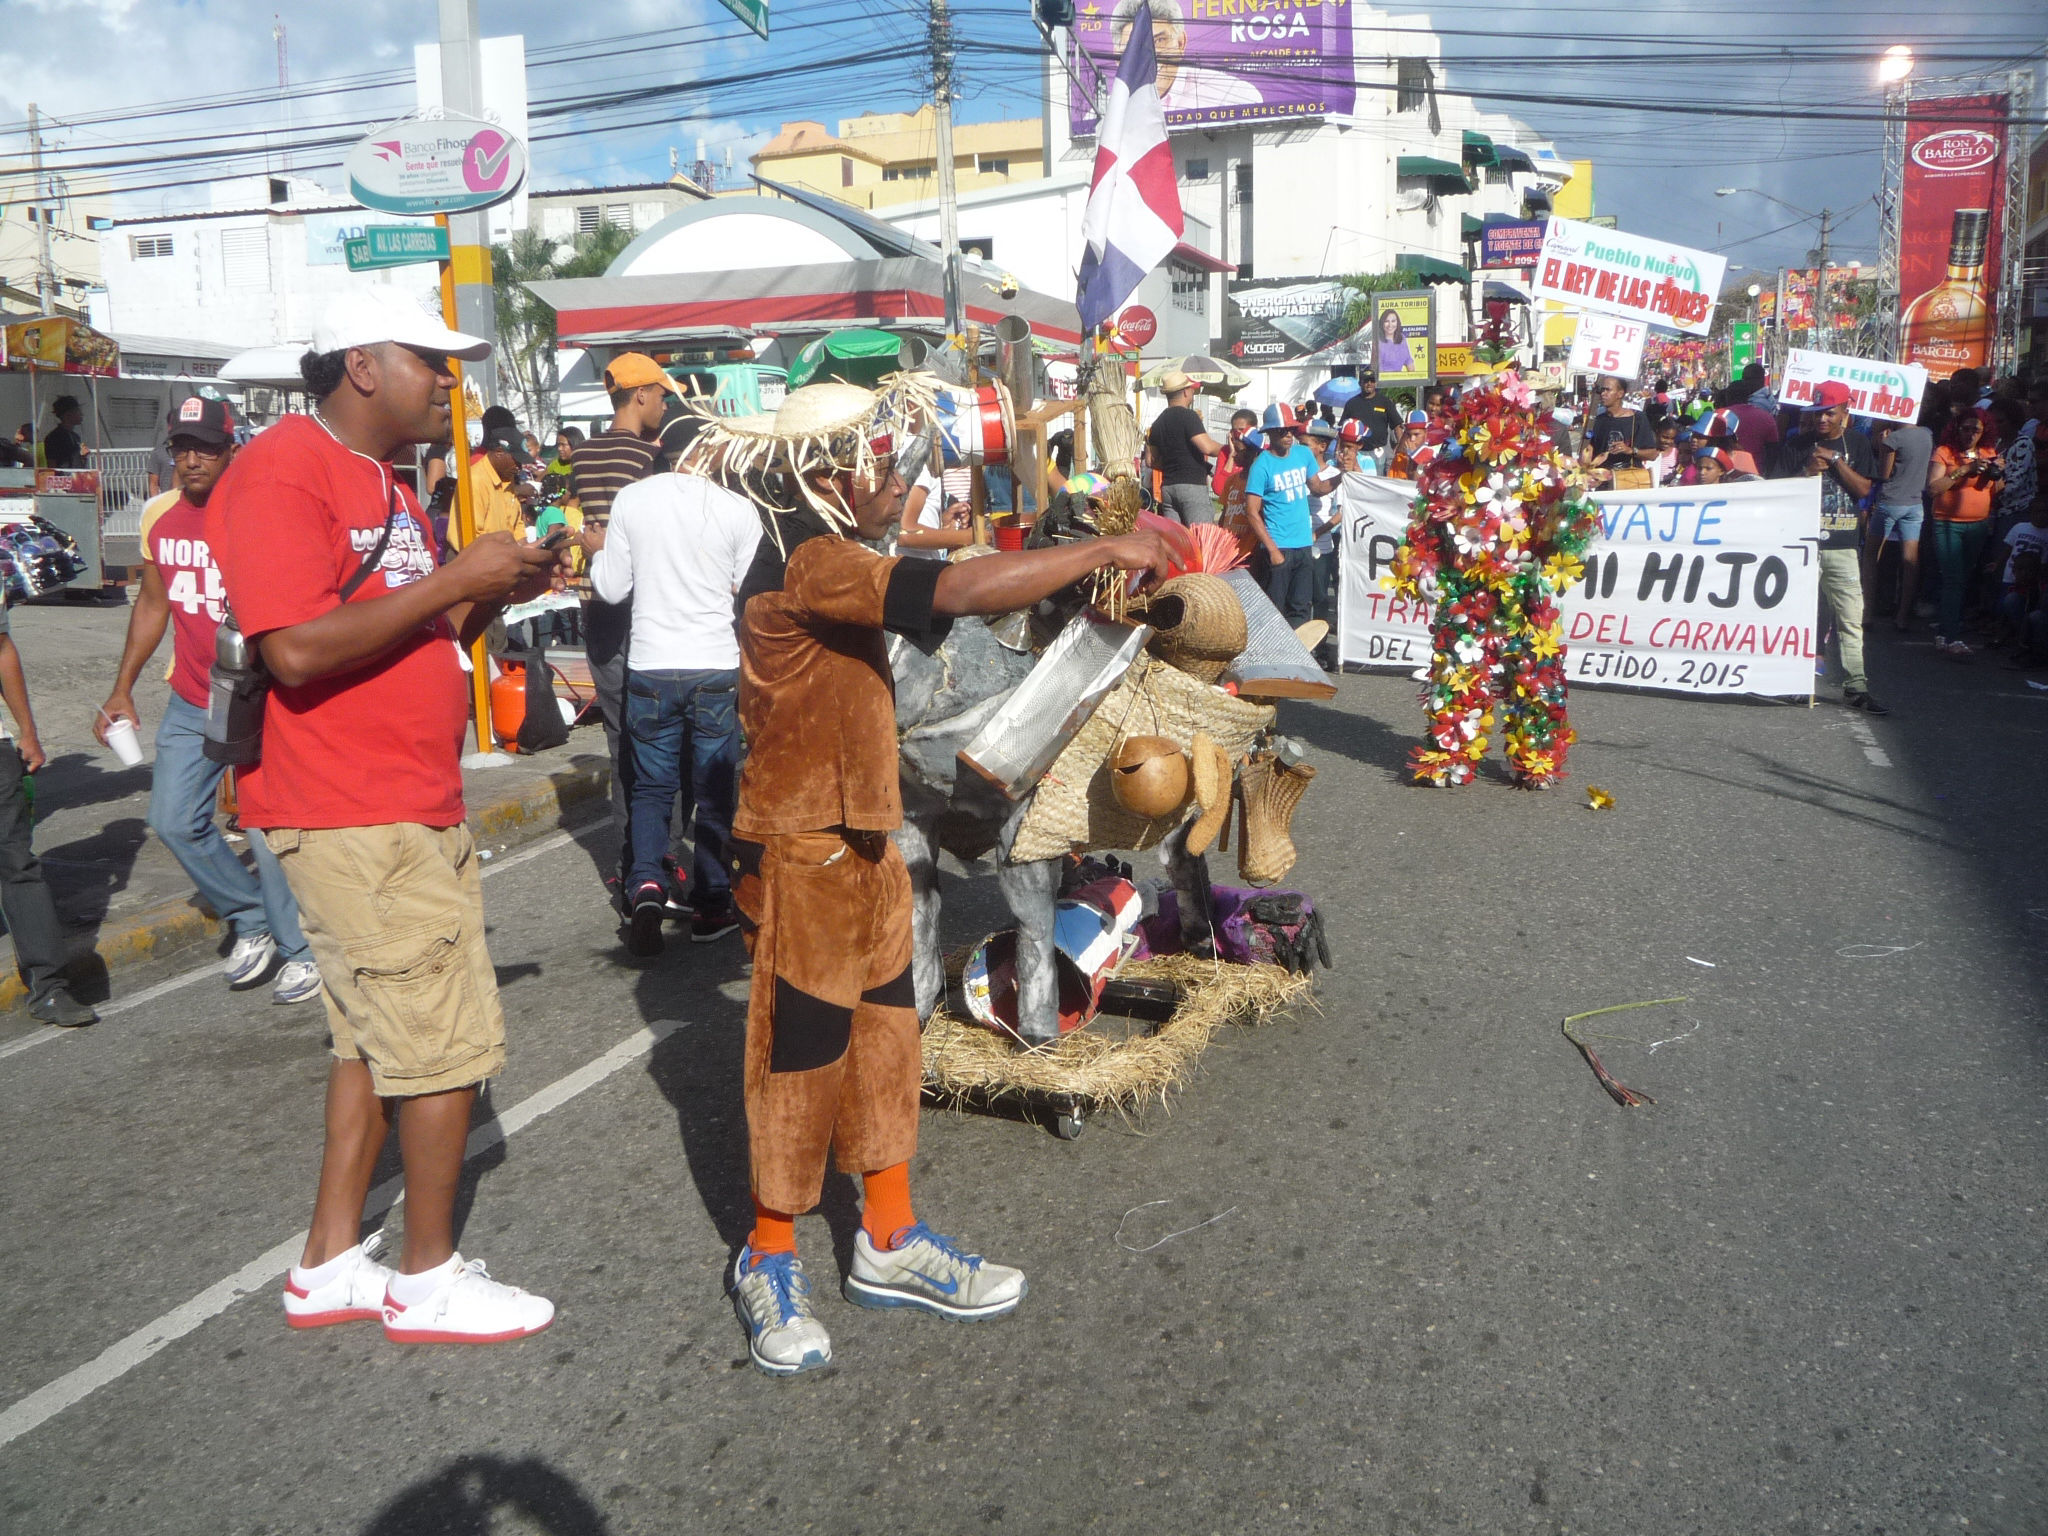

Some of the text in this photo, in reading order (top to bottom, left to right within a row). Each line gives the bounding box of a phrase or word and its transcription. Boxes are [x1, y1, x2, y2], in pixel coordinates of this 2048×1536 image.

[1081, 21, 1102, 32] PLD
[1231, 12, 1310, 43] ROSA
[1167, 102, 1327, 124] UDAD QUE MERECEMOS
[404, 142, 436, 154] Banco
[1924, 144, 1988, 159] BARCELÓ
[1943, 139, 1970, 149] RON
[405, 162, 425, 171] Gente
[426, 161, 439, 170] que
[376, 233, 437, 252] AV. LAS CARRERAS
[1523, 239, 1533, 249] DE
[351, 245, 369, 263] SAB
[1584, 240, 1641, 269] Pueblo
[1644, 256, 1694, 281] Nuevo
[1541, 257, 1710, 324] EL REY DE LAS FLORES
[1240, 304, 1324, 318] Y CONFIABLE
[1612, 325, 1640, 343] PF
[1244, 343, 1285, 354] KYOCERA
[1439, 353, 1467, 361] NCA
[1912, 343, 1970, 360] BARCELÓ
[192, 362, 223, 374] RETE
[1587, 347, 1620, 372] 15
[1828, 365, 1844, 377] El
[1850, 368, 1900, 387] Ejido
[1785, 379, 1814, 402] PA
[1869, 392, 1914, 418] HIJO
[1273, 467, 1307, 492] AERO
[1286, 485, 1304, 503] NY
[159, 538, 218, 568] NOR
[1368, 535, 1398, 580] P
[1637, 551, 1789, 609] HIJO
[1366, 594, 1816, 659] TRA DEL CARNAVAL
[1369, 635, 1415, 661] DEL
